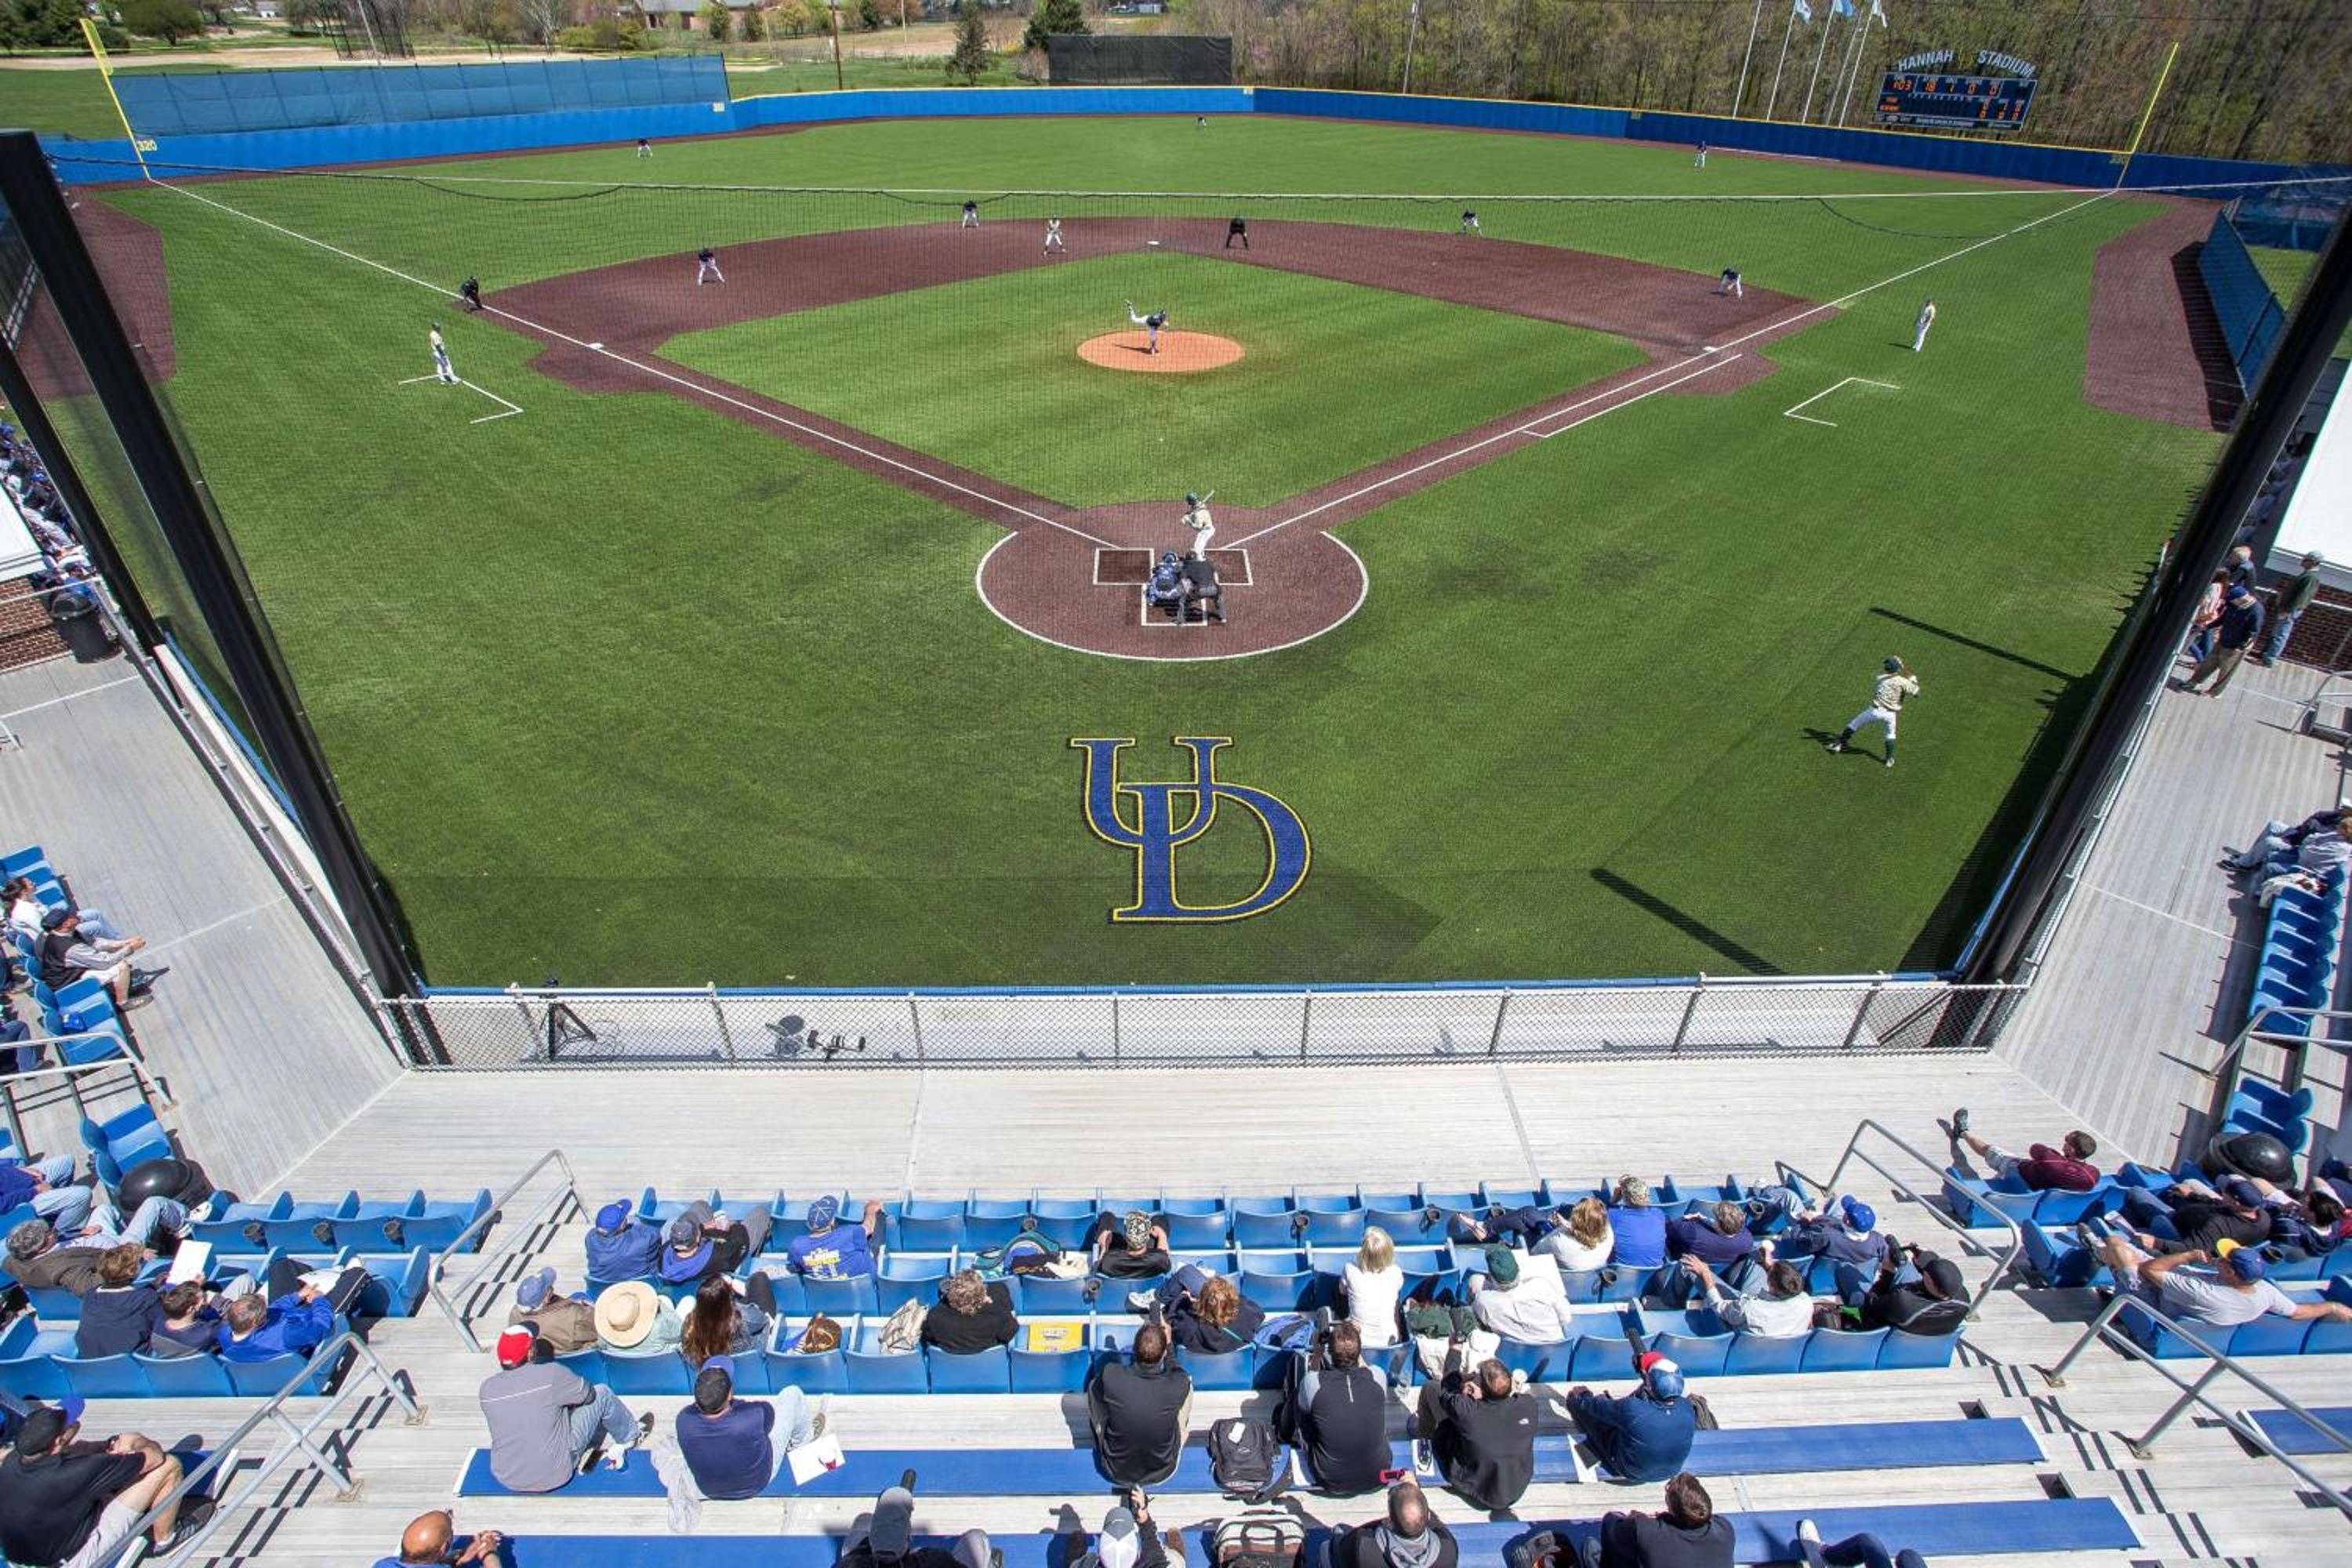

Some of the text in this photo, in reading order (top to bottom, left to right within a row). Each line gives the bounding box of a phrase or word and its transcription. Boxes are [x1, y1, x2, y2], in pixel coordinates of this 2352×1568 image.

[1898, 50, 2036, 78] HANNAH STADIUM
[136, 140, 157, 151] 320
[1069, 736, 1312, 922] UD
